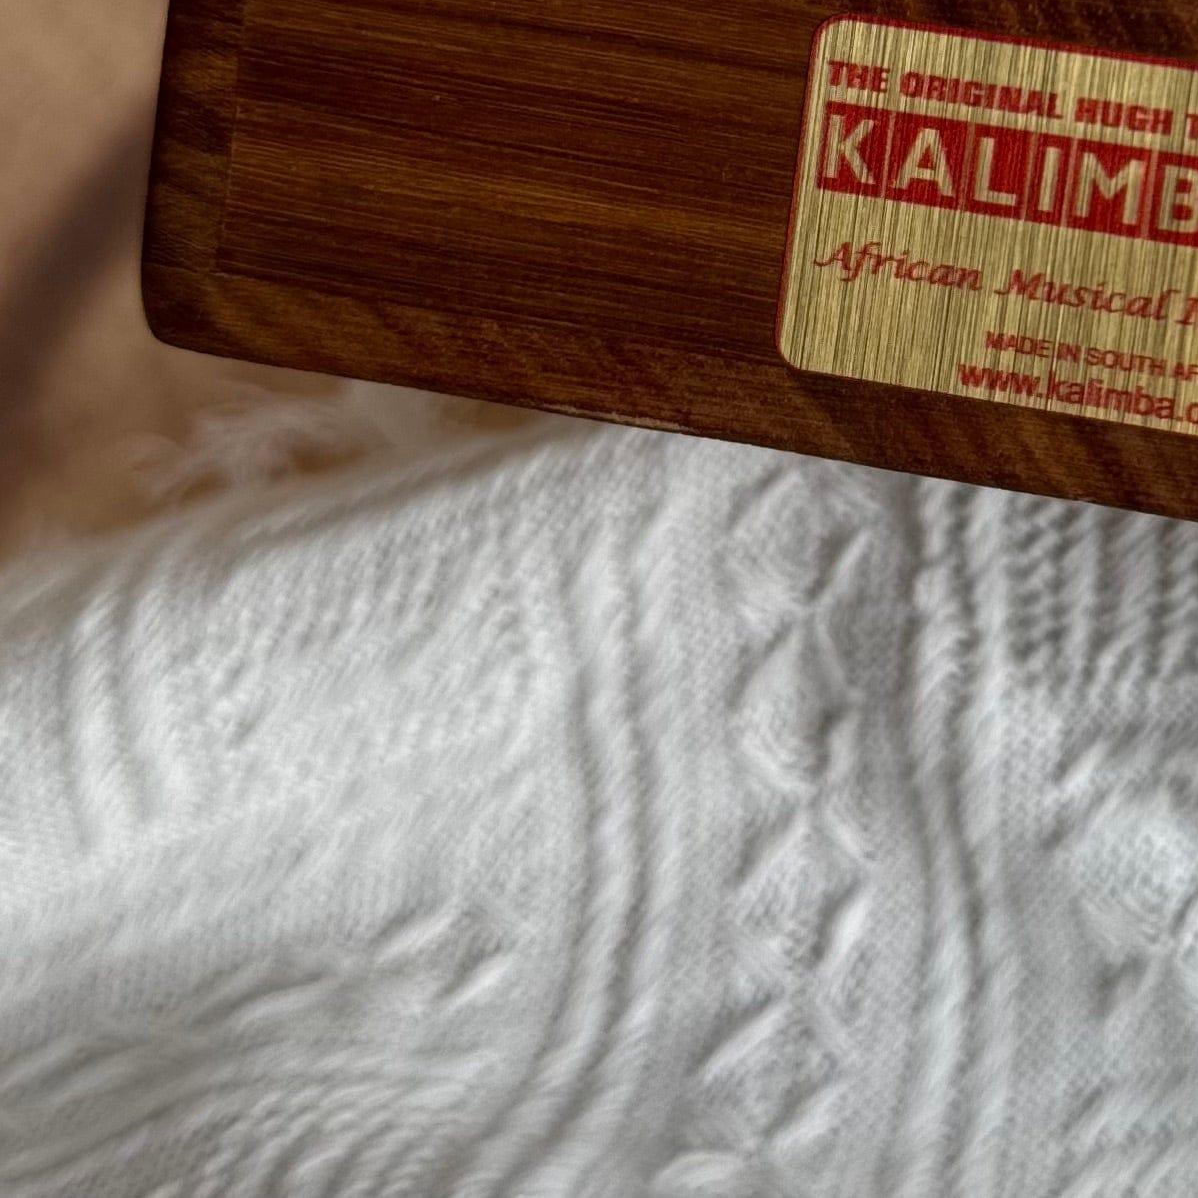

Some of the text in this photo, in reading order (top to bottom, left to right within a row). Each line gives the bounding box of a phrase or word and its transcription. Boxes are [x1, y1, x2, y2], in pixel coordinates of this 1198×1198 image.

[827, 59, 890, 93] THE
[900, 71, 1064, 120] ORIGINAL
[1074, 97, 1174, 136] HUGH
[814, 241, 982, 291] African
[994, 268, 1179, 322] Musical
[985, 330, 1053, 359] MADE
[1056, 340, 1081, 364] IN
[1086, 347, 1166, 378] SOUTH
